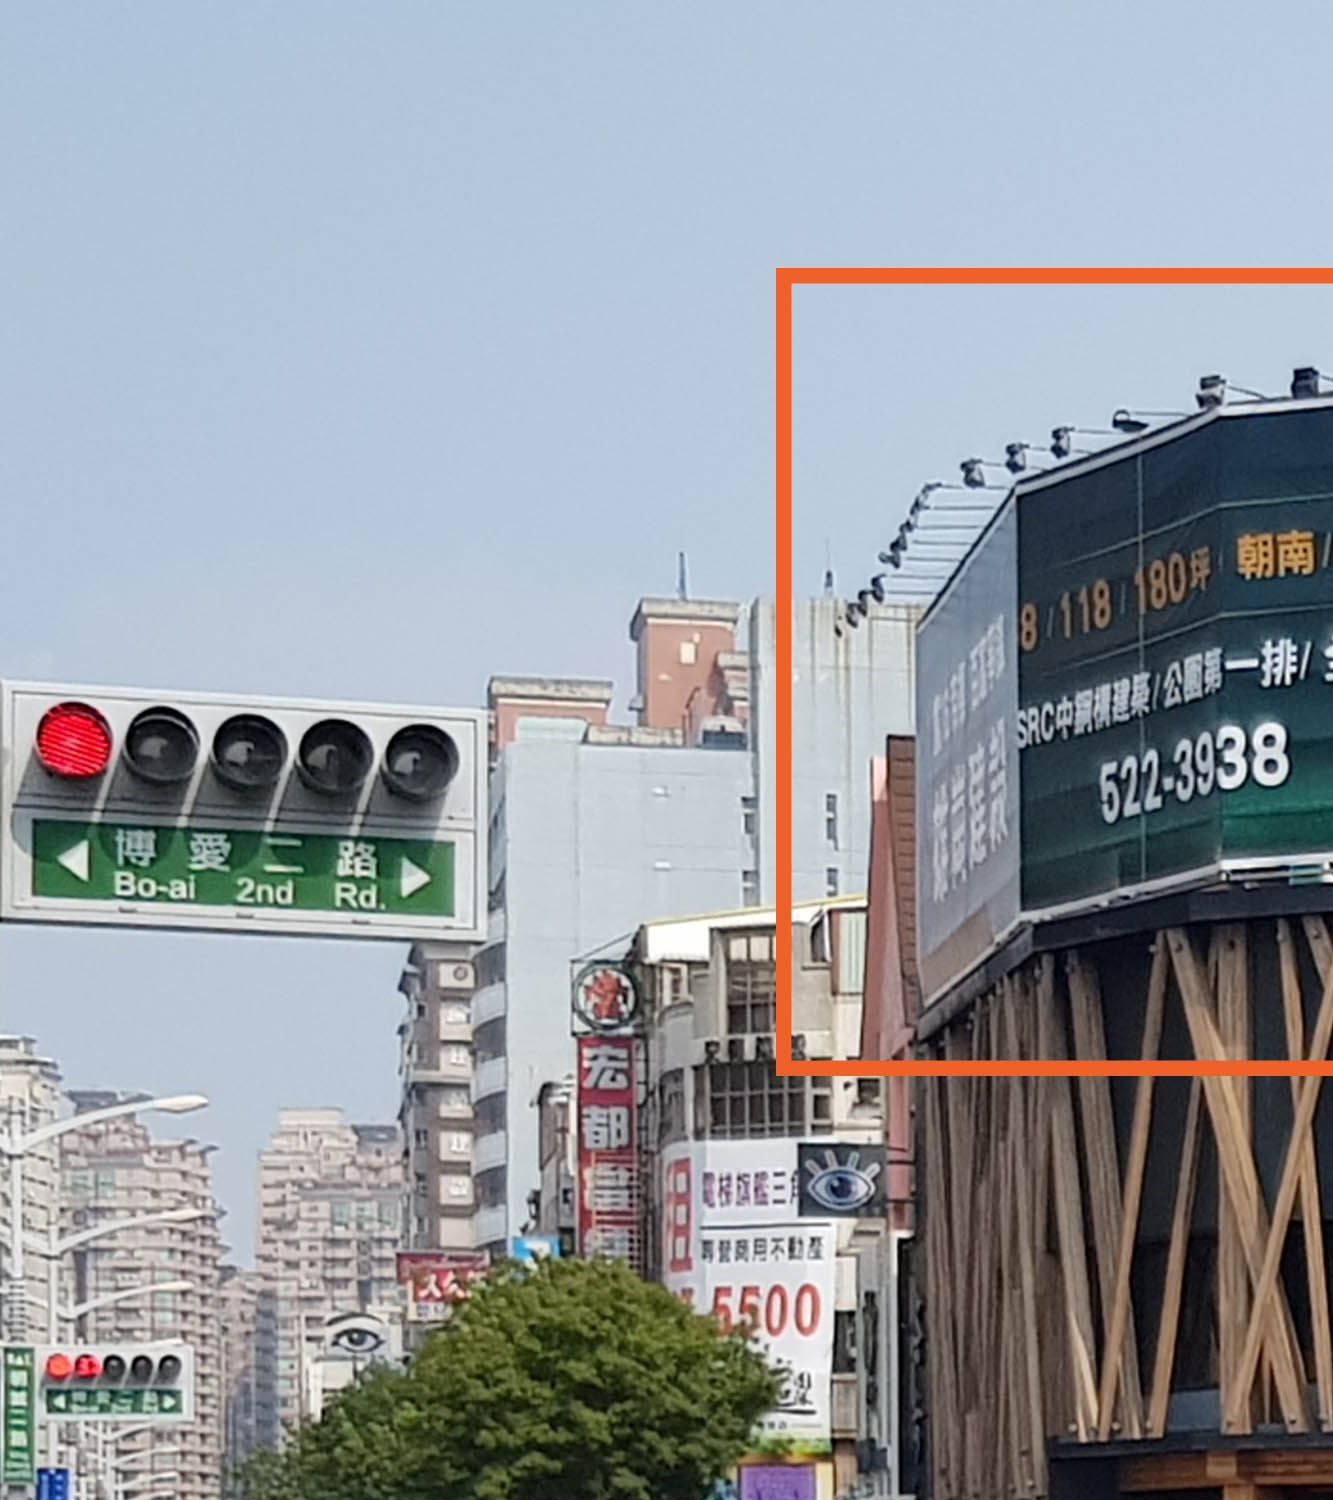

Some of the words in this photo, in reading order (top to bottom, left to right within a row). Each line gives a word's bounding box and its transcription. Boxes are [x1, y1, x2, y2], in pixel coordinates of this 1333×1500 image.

[1237, 529, 1316, 580] 朝南
[1099, 722, 1290, 825] 522-3938
[114, 828, 378, 882] 博愛二路
[113, 871, 196, 900] Bo-ai
[236, 877, 294, 905] 2nd
[334, 883, 387, 910] Rd.
[713, 1283, 821, 1339] 5500
